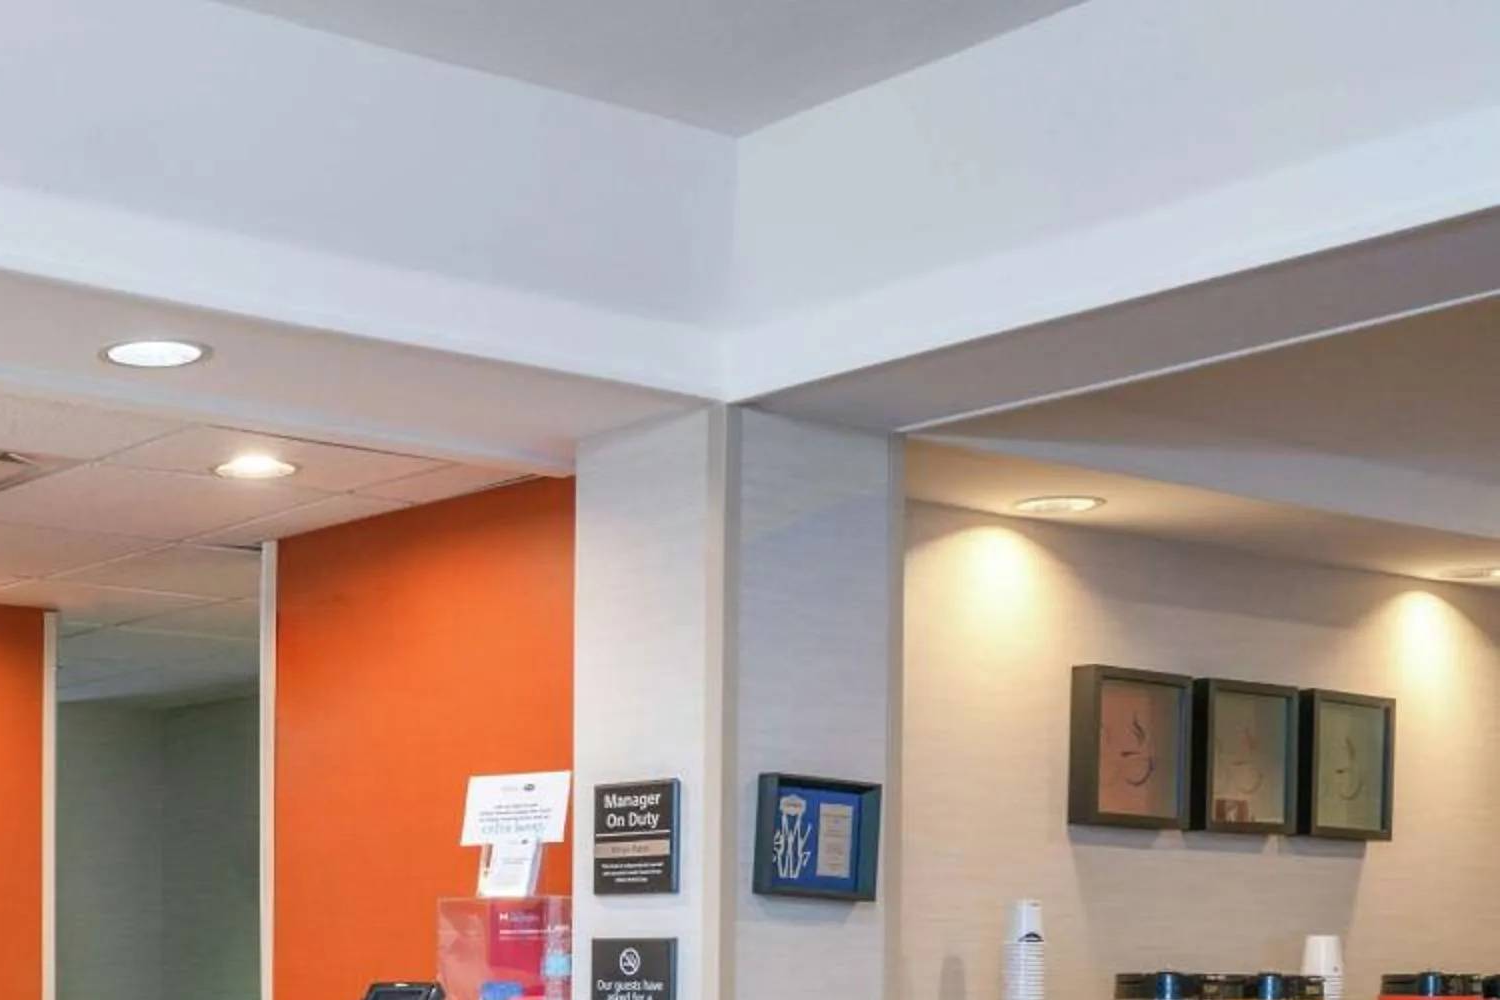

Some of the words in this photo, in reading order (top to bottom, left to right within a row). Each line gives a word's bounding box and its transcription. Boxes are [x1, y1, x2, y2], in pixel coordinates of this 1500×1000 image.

[603, 793, 661, 810] Manager
[606, 813, 626, 828] On
[628, 812, 660, 829] Duty
[597, 980, 613, 991] Our
[614, 981, 641, 993] guests
[642, 980, 664, 990] have
